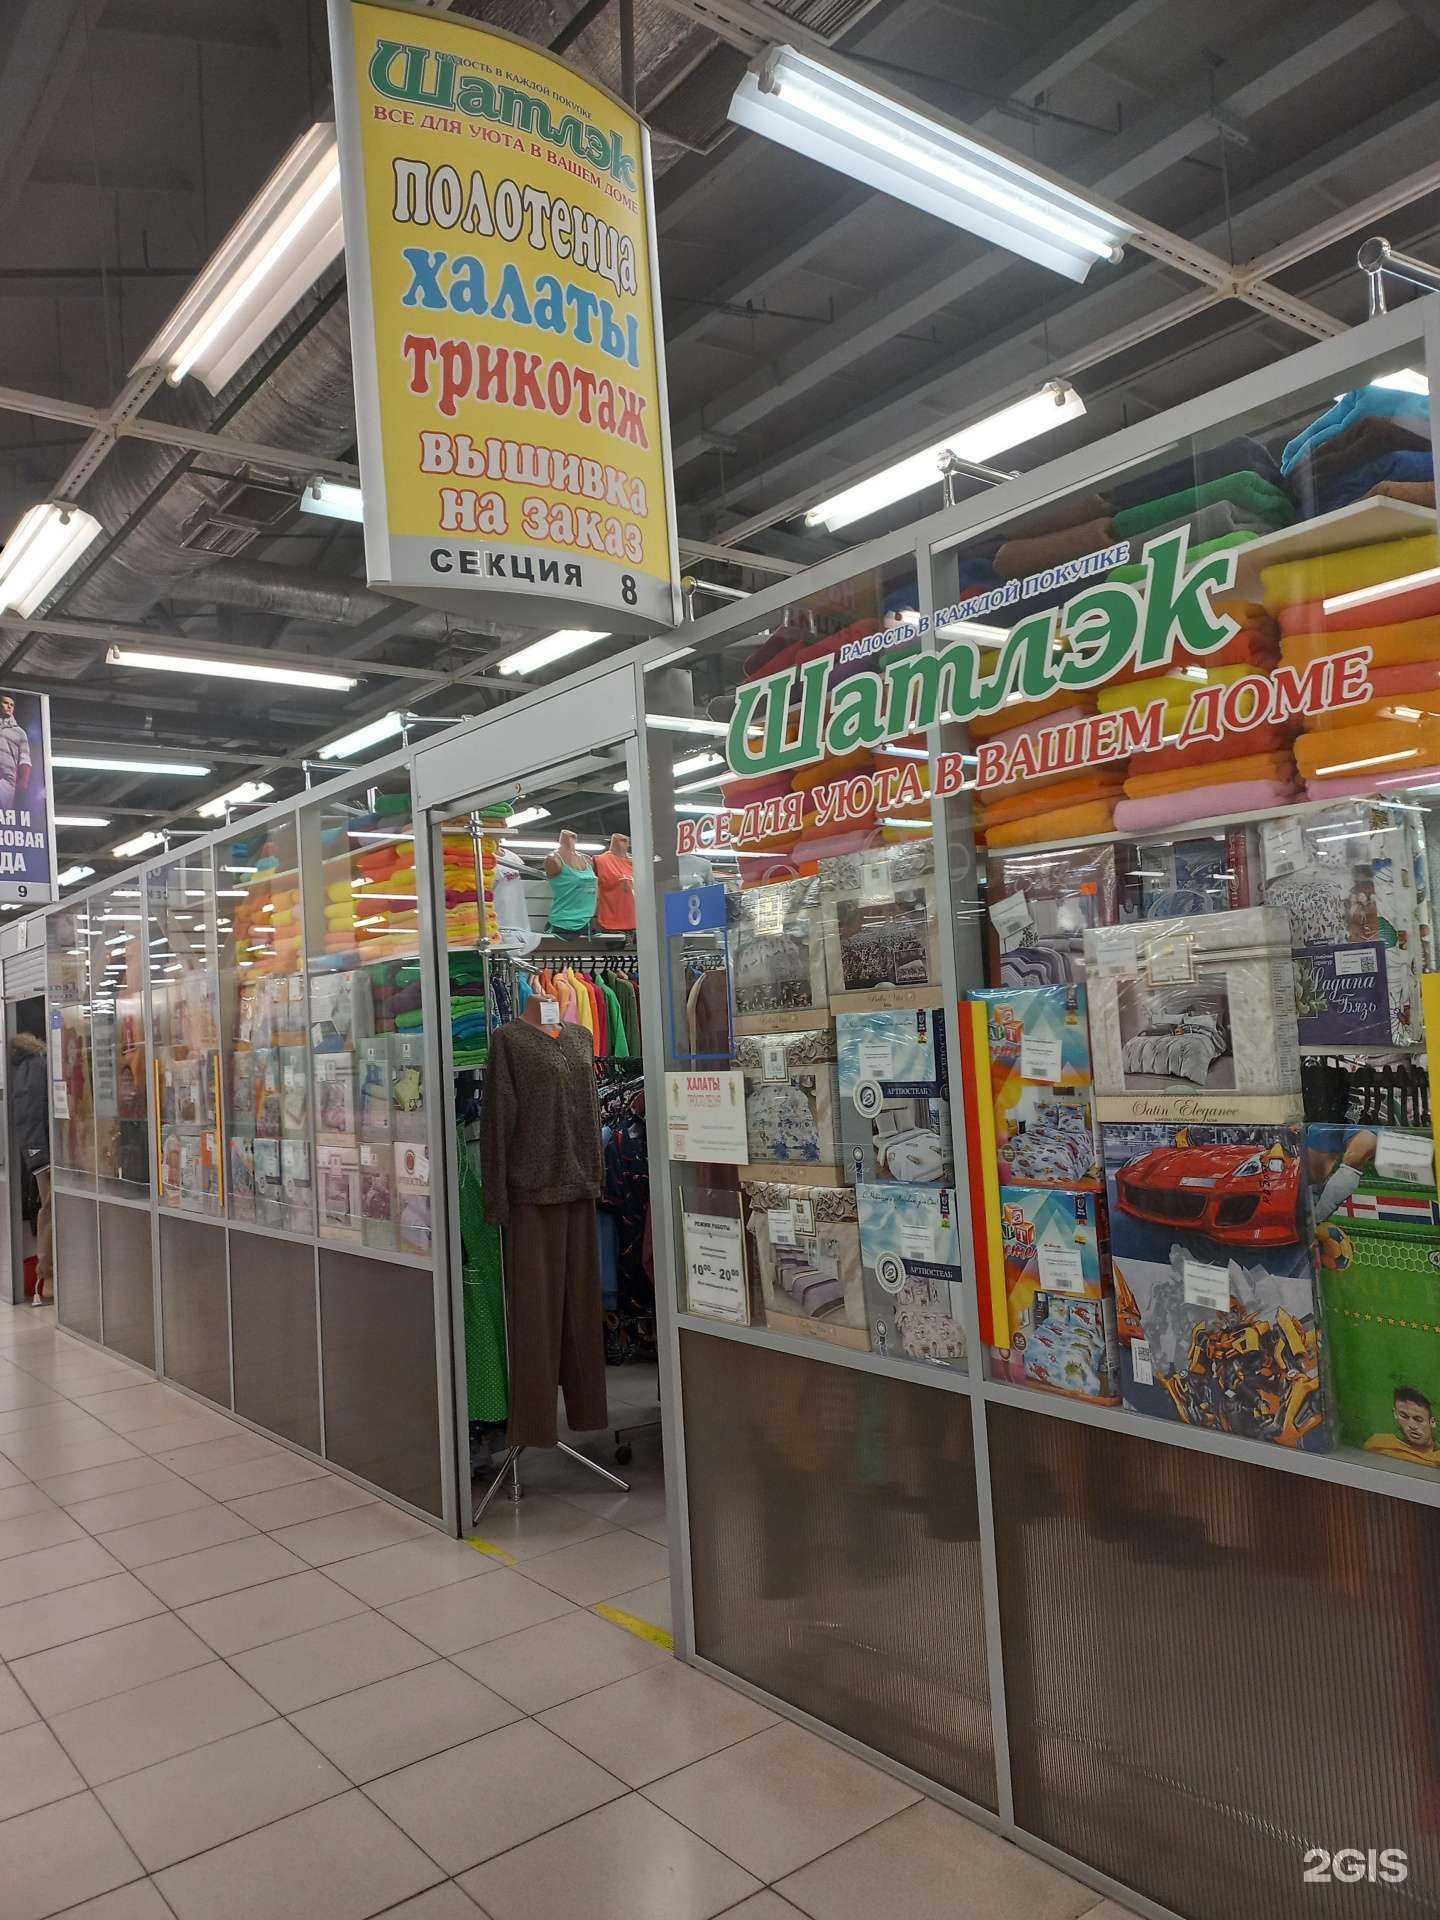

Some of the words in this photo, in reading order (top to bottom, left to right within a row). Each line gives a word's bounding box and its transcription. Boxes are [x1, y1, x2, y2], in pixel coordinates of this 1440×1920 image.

[369, 40, 638, 193] Шатлэк
[496, 67, 503, 77] В
[505, 71, 550, 98] КАЖДОЙ
[552, 91, 593, 121] ПОКУПКЕ
[373, 105, 415, 126] ВСЕ
[420, 114, 462, 135] ДЛЯ
[469, 123, 526, 153] УЮТА
[530, 143, 542, 158] В
[547, 149, 601, 190] ВАШЕМ
[604, 182, 640, 215] ДОМЕ
[430, 548, 584, 588] СЕКЦИЯ
[621, 574, 638, 605] 8
[840, 627, 916, 663] РАДОСТЬ
[918, 614, 930, 637] В
[934, 577, 1020, 628] КАЖДОЙ
[1023, 541, 1130, 599] ПОКУПКЕ
[724, 524, 1241, 779] Шатлэк
[676, 808, 731, 856] ВСЕ
[738, 789, 804, 847] ДЛЯ
[811, 762, 921, 826] УЮТА
[936, 751, 965, 794] В
[976, 701, 1167, 786] ВАШЕМ
[1179, 646, 1374, 752] ДОМЕ
[20, 810, 31, 827] И
[18, 885, 28, 898] 9
[688, 894, 702, 926] 8
[1309, 966, 1376, 1000] Laguna
[1331, 993, 1377, 1021] Бязь
[1132, 1100, 1169, 1117] Satin
[1173, 1099, 1240, 1121] Elegance
